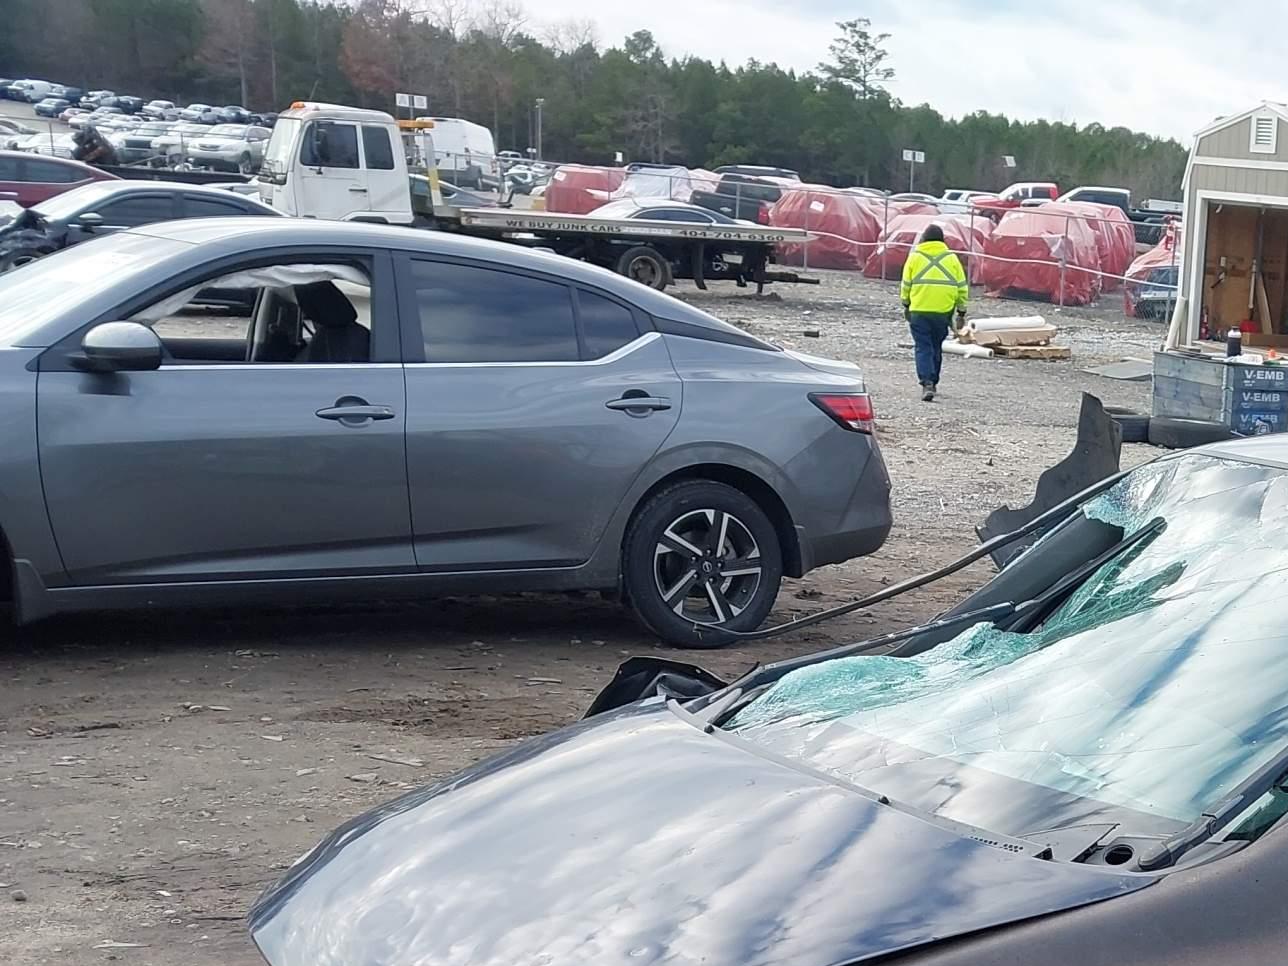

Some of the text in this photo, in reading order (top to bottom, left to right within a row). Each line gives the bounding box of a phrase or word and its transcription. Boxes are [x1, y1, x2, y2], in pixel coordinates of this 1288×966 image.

[506, 219, 526, 228] WE
[528, 221, 552, 229] BUY
[557, 222, 588, 231] JUNK
[591, 224, 622, 233] CARS
[679, 229, 785, 242] 404-704-6360
[1244, 369, 1285, 381] V-EMB
[1242, 391, 1281, 402] V-EMB
